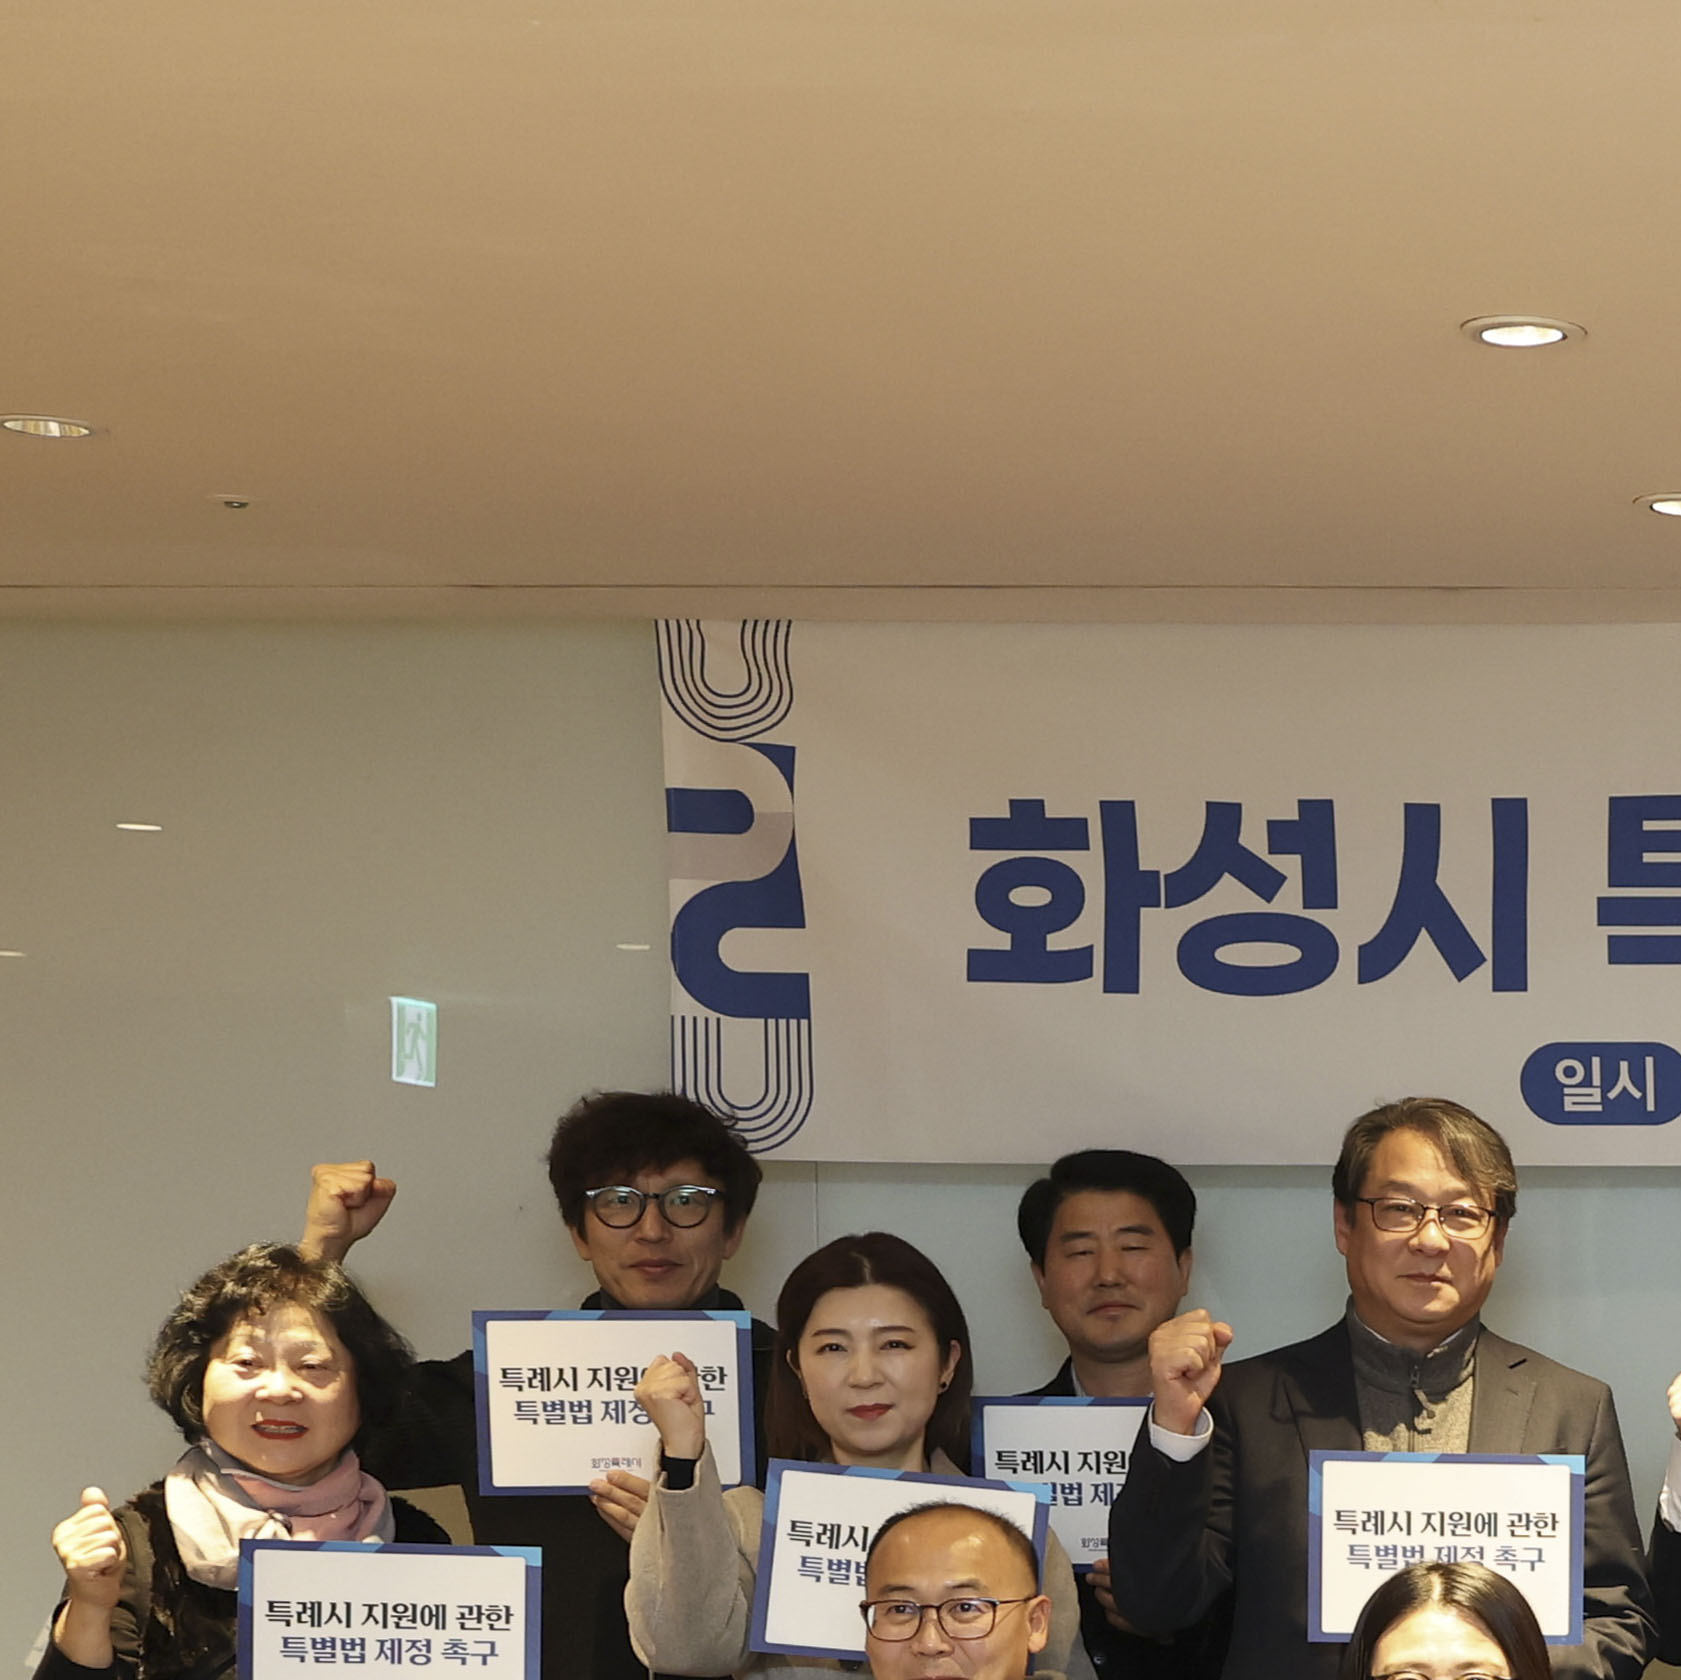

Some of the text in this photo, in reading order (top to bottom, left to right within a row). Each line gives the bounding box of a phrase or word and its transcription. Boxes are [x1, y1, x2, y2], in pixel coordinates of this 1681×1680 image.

[967, 798, 1528, 996] 화성시
[1556, 1057, 1654, 1111] 일시
[500, 1367, 578, 1392] 특례시
[587, 1366, 645, 1392] 지원
[514, 1400, 592, 1425] 특별법
[995, 1450, 1128, 1474] 특례시 지원
[786, 1519, 869, 1553] 특례시
[1334, 1510, 1559, 1538] 특례시 지원에 관한
[1494, 1545, 1546, 1572] 촉구
[265, 1601, 514, 1631] 특례시 지원에 관한
[280, 1637, 498, 1666] 특별법 제정 촉구
